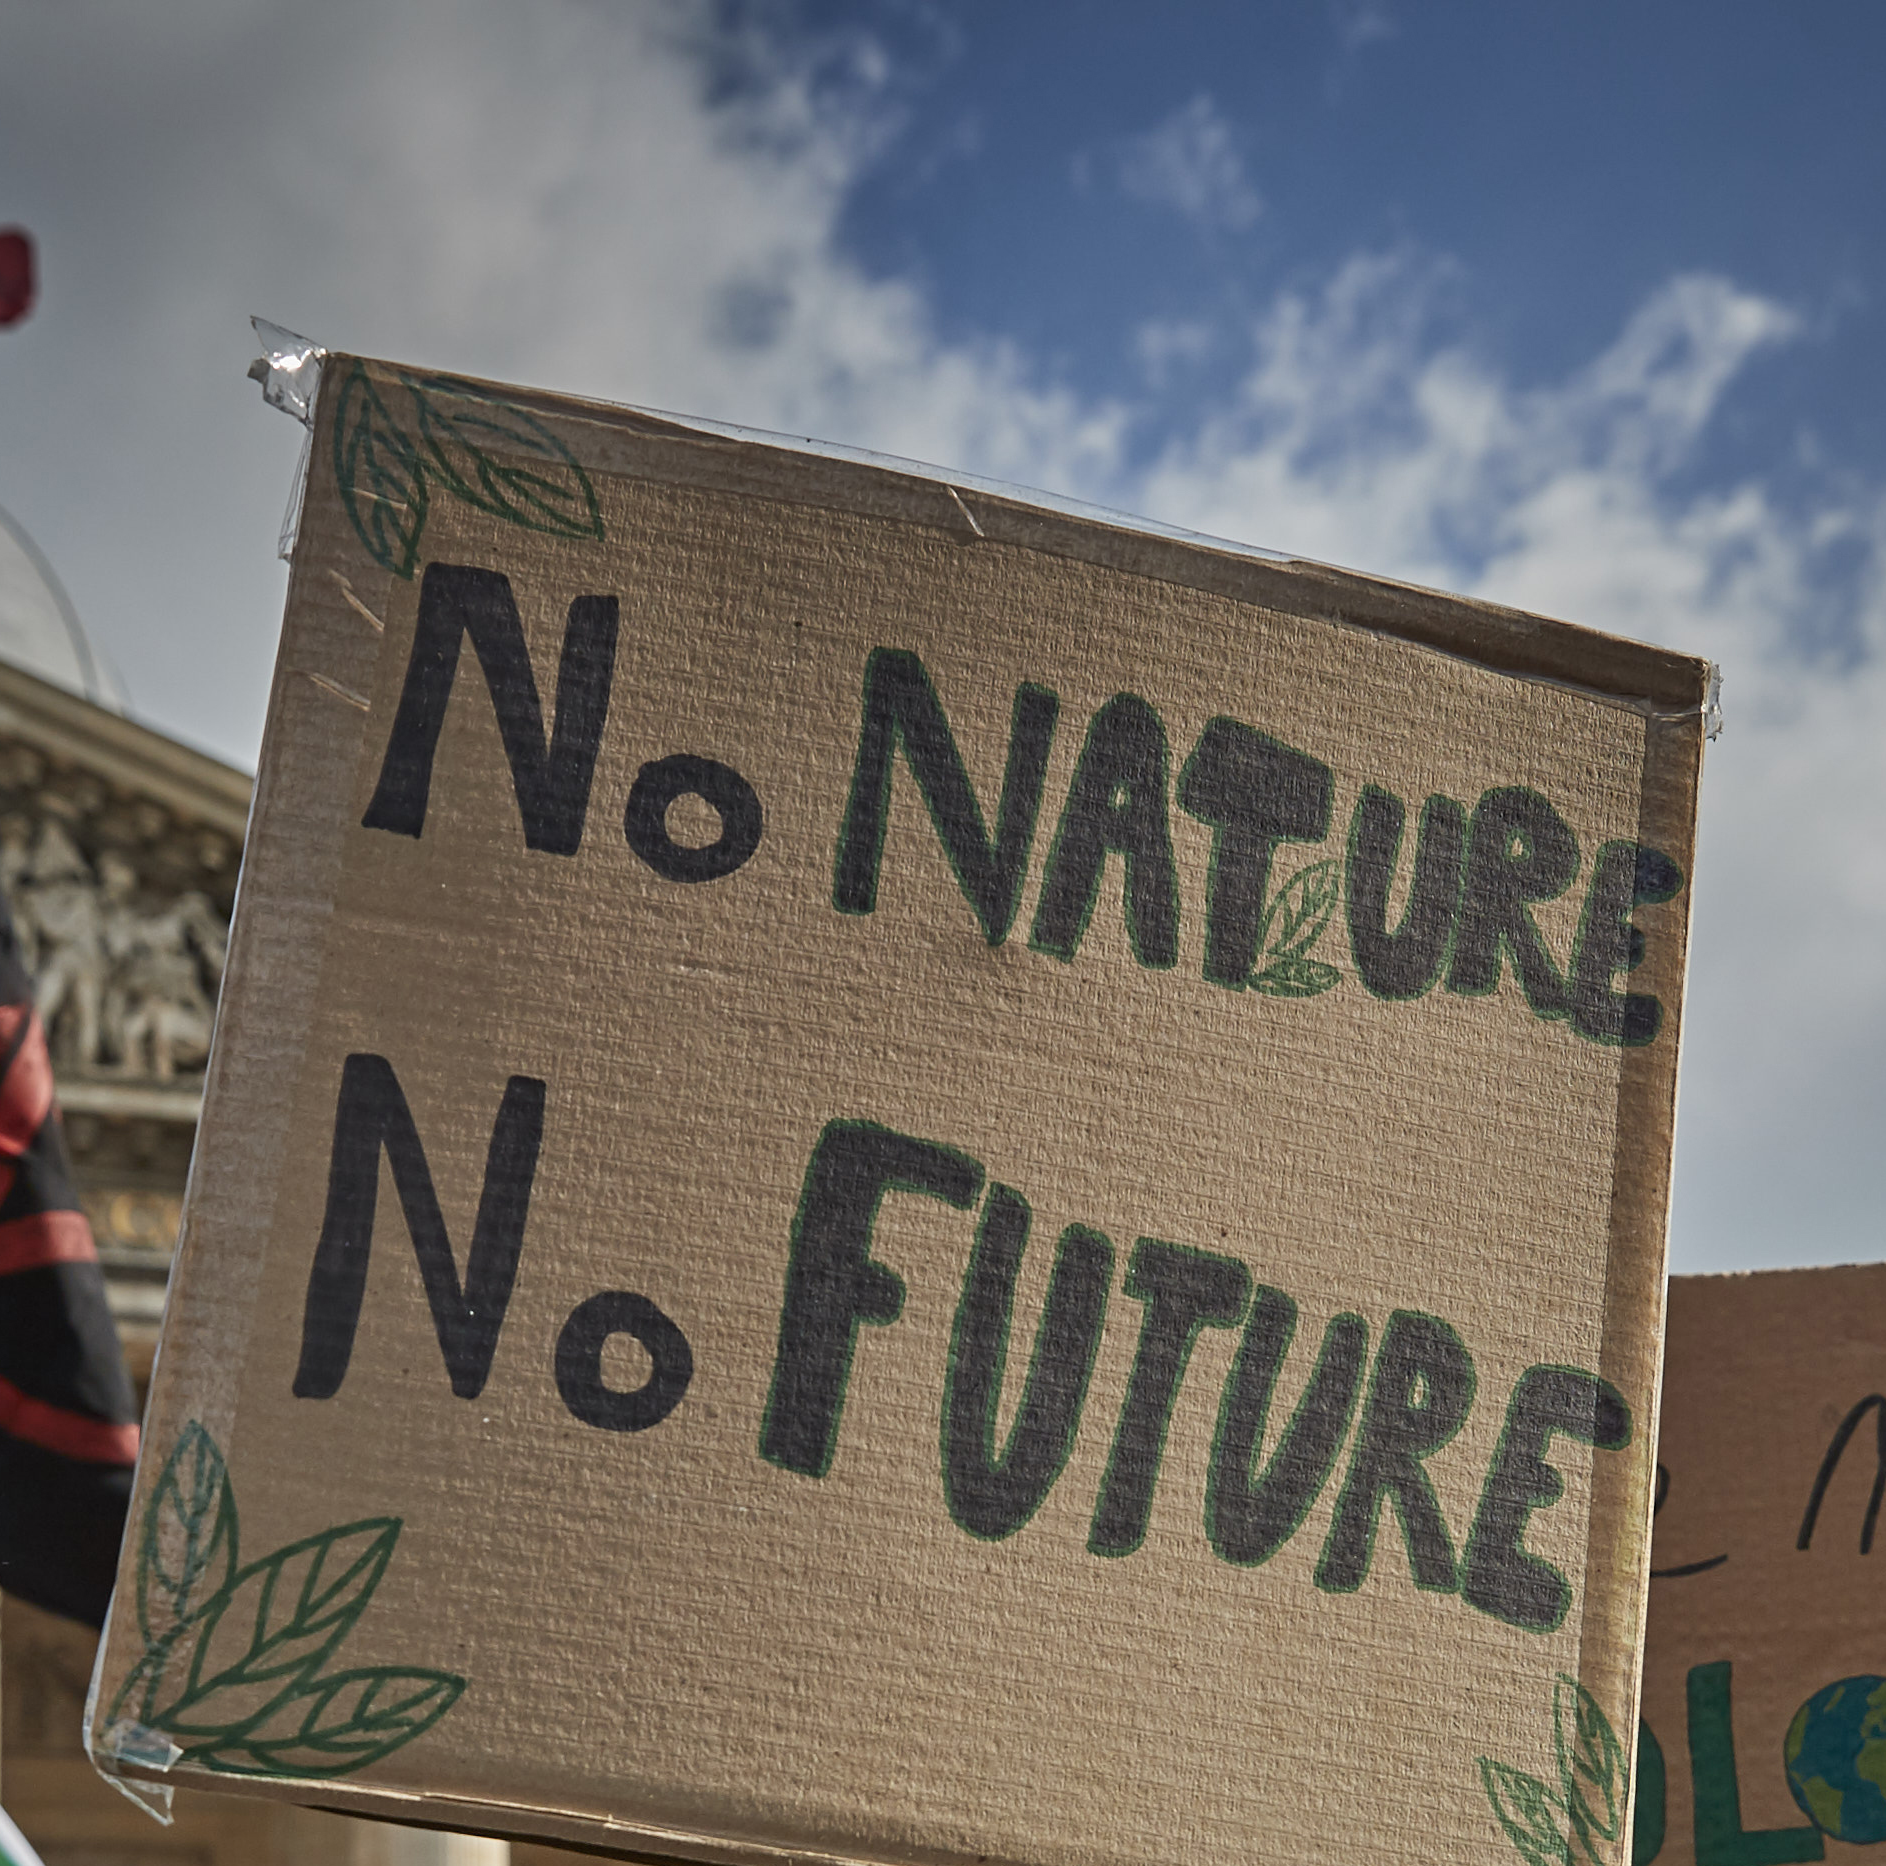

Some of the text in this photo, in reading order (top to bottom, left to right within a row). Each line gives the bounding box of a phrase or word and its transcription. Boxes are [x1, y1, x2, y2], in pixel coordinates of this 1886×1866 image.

[361, 560, 1685, 1047] No NATURE
[291, 1051, 1634, 1634] No FUTURE
